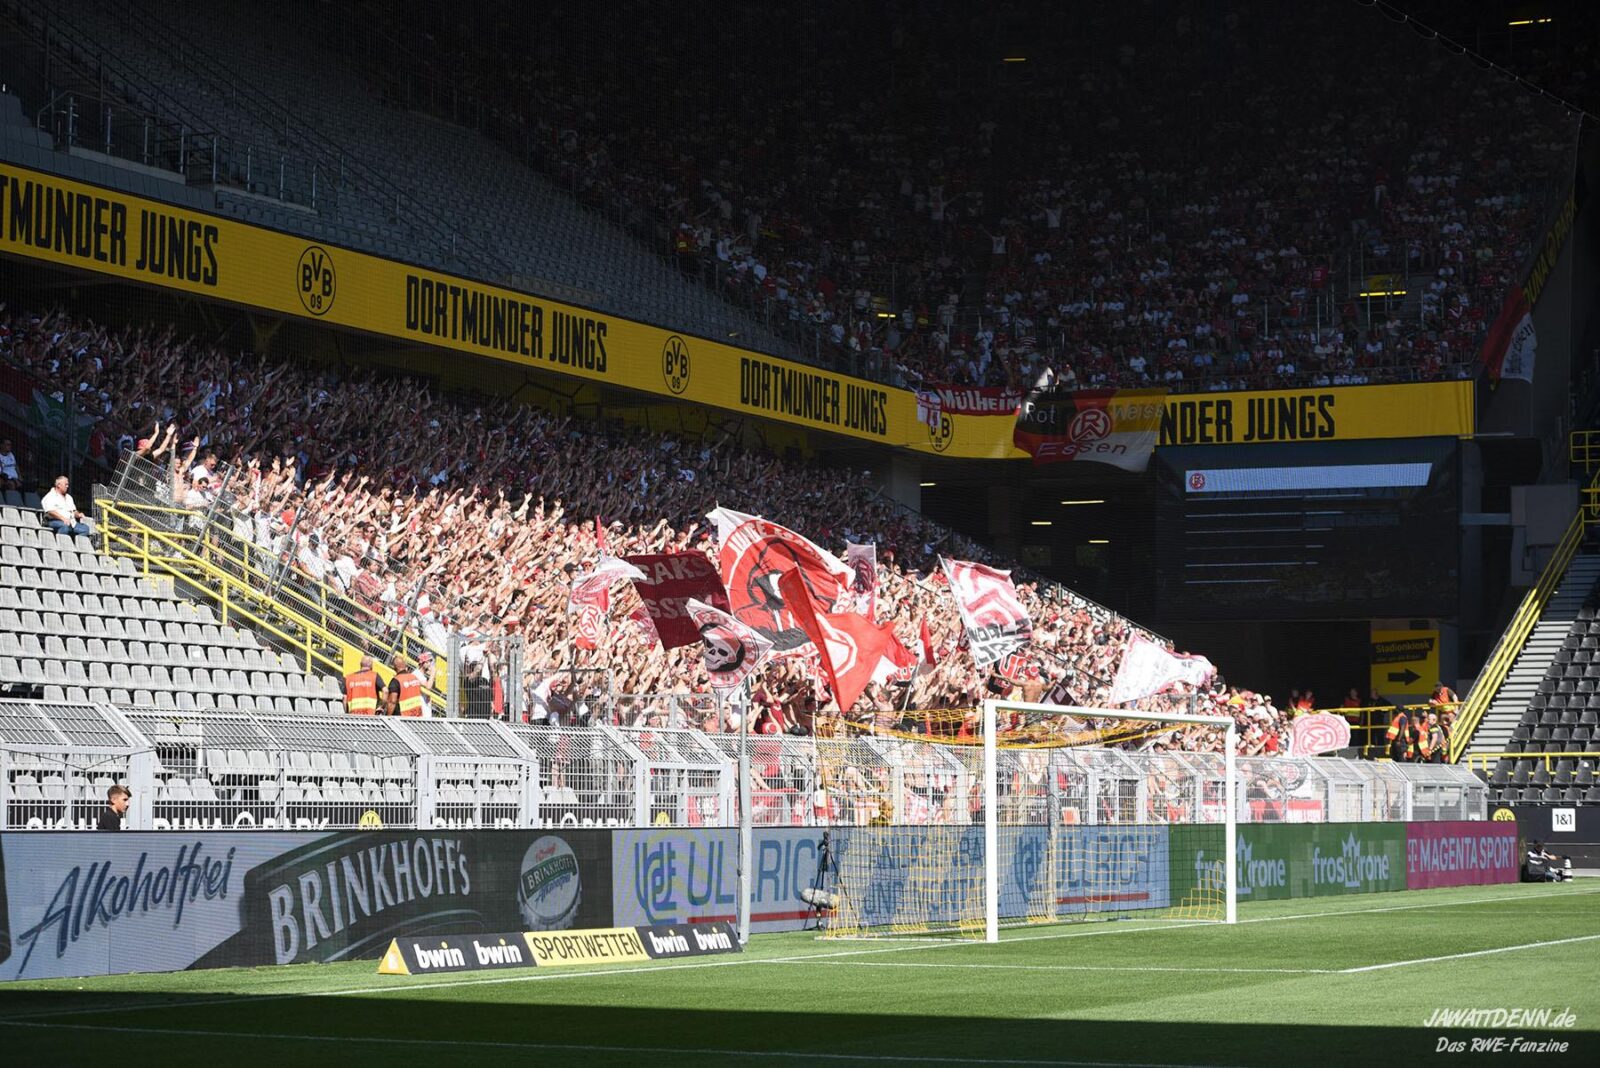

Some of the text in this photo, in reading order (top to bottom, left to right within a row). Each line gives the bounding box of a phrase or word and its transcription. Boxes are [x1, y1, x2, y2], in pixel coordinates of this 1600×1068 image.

[136, 209, 219, 286] JUNGS
[302, 252, 332, 297] BVB
[406, 274, 607, 373] DORTMUNDER JUNGS
[666, 341, 688, 378] BVB
[741, 357, 840, 425] DORTMUNDER
[844, 384, 887, 435] JUNGS
[1243, 394, 1335, 442] JUNGS
[1037, 442, 1127, 457] Essen
[1555, 814, 1572, 825] 1&1
[1420, 837, 1478, 872] MAGENTA
[1480, 836, 1516, 870] SPORT
[17, 843, 237, 980] Alkoholfrei
[413, 926, 732, 969] bwin bwin SPORTWETTEN bwin bwin
